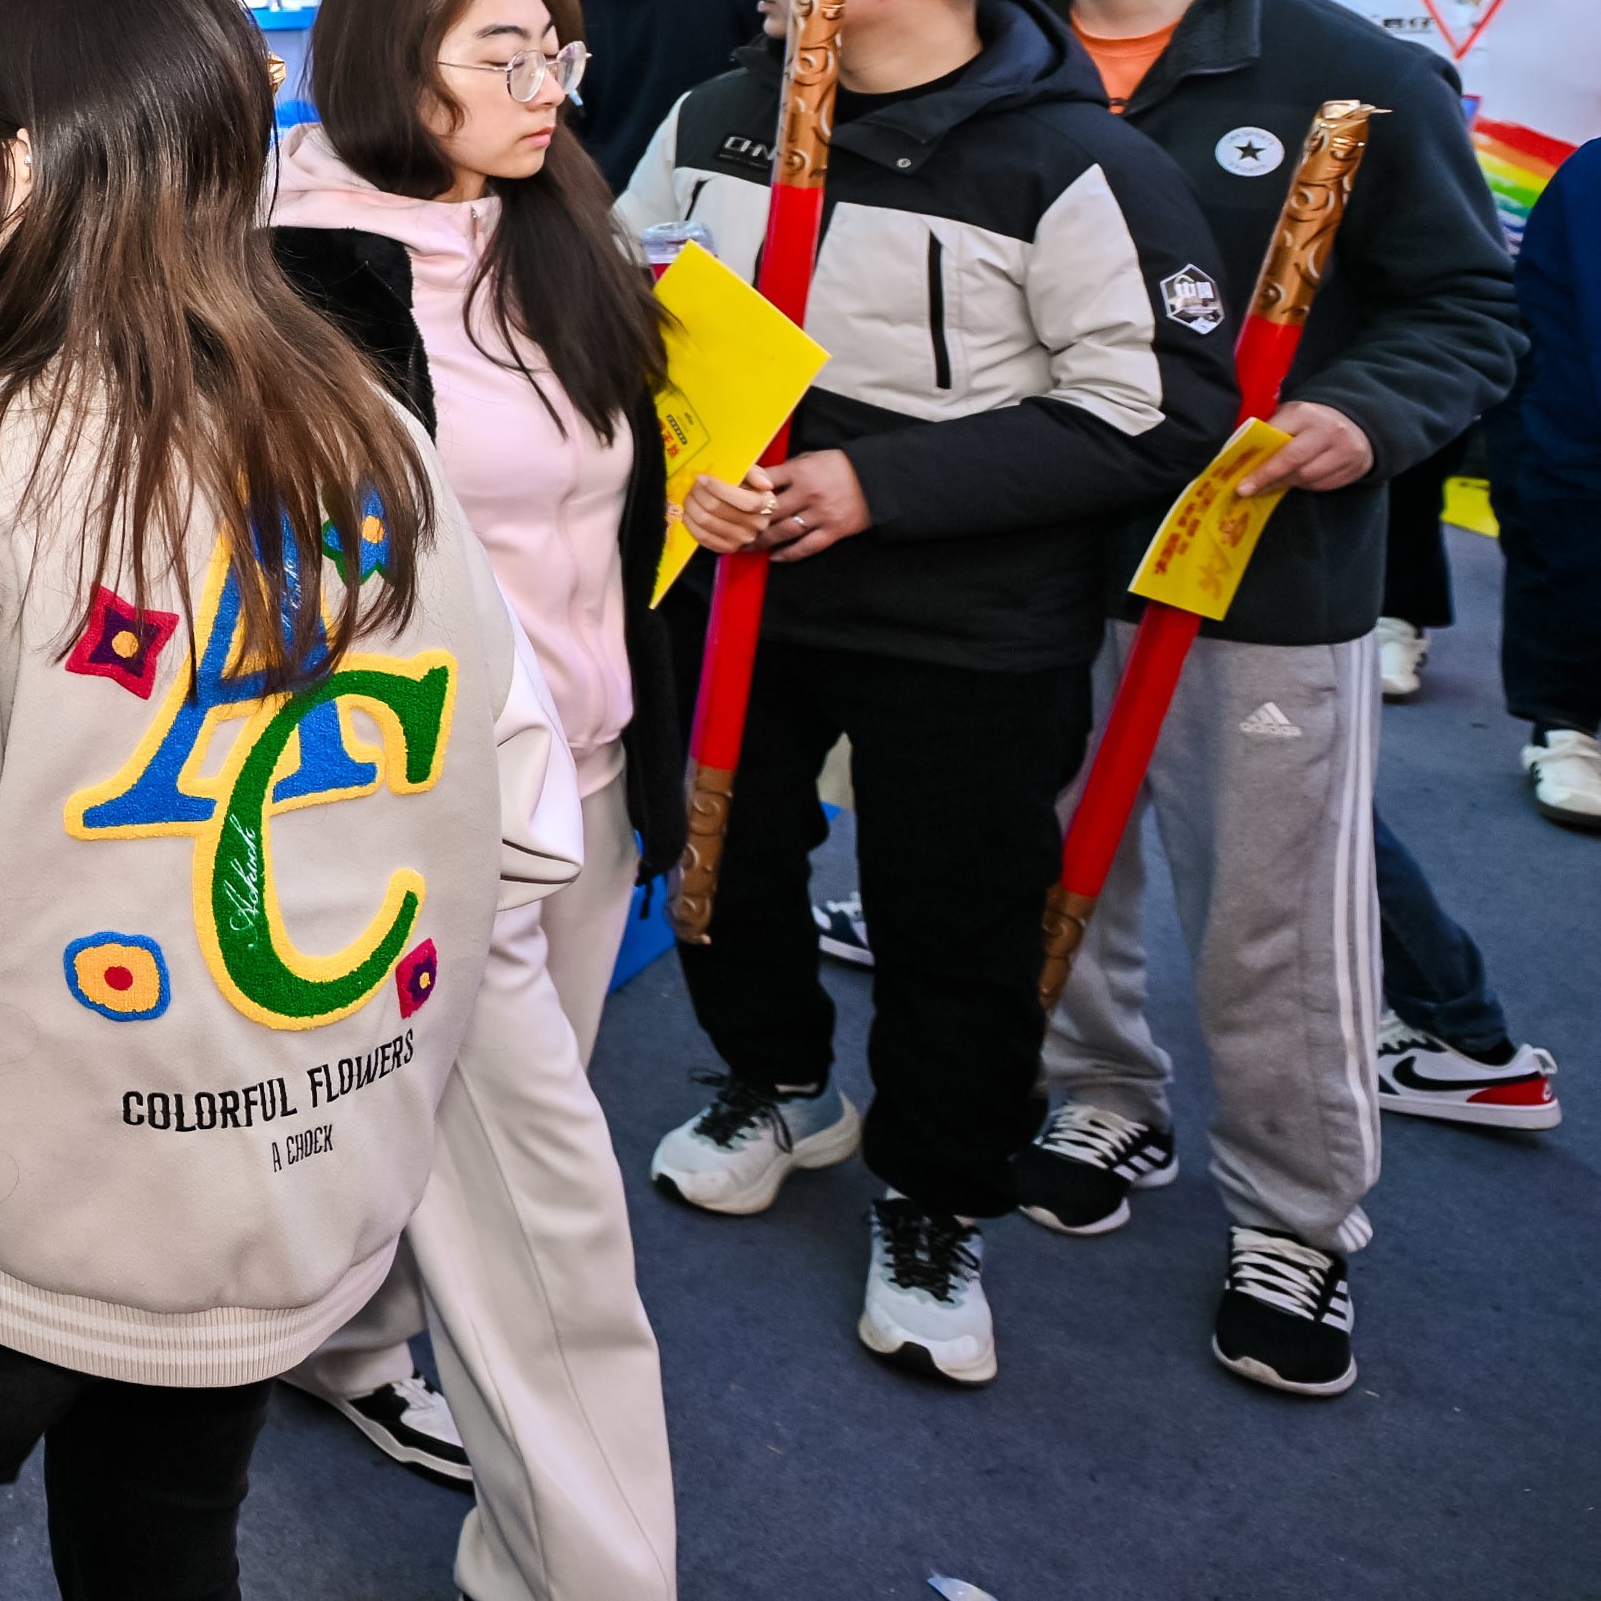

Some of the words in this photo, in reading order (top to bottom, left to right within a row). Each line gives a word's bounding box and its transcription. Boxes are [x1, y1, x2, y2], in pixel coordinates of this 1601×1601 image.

[1239, 721, 1303, 737] adidas
[122, 1076, 298, 1134] COLORFUL
[305, 1028, 416, 1111] FLOWERS
[272, 1141, 283, 1173] A
[286, 1123, 334, 1166] CHOCK
